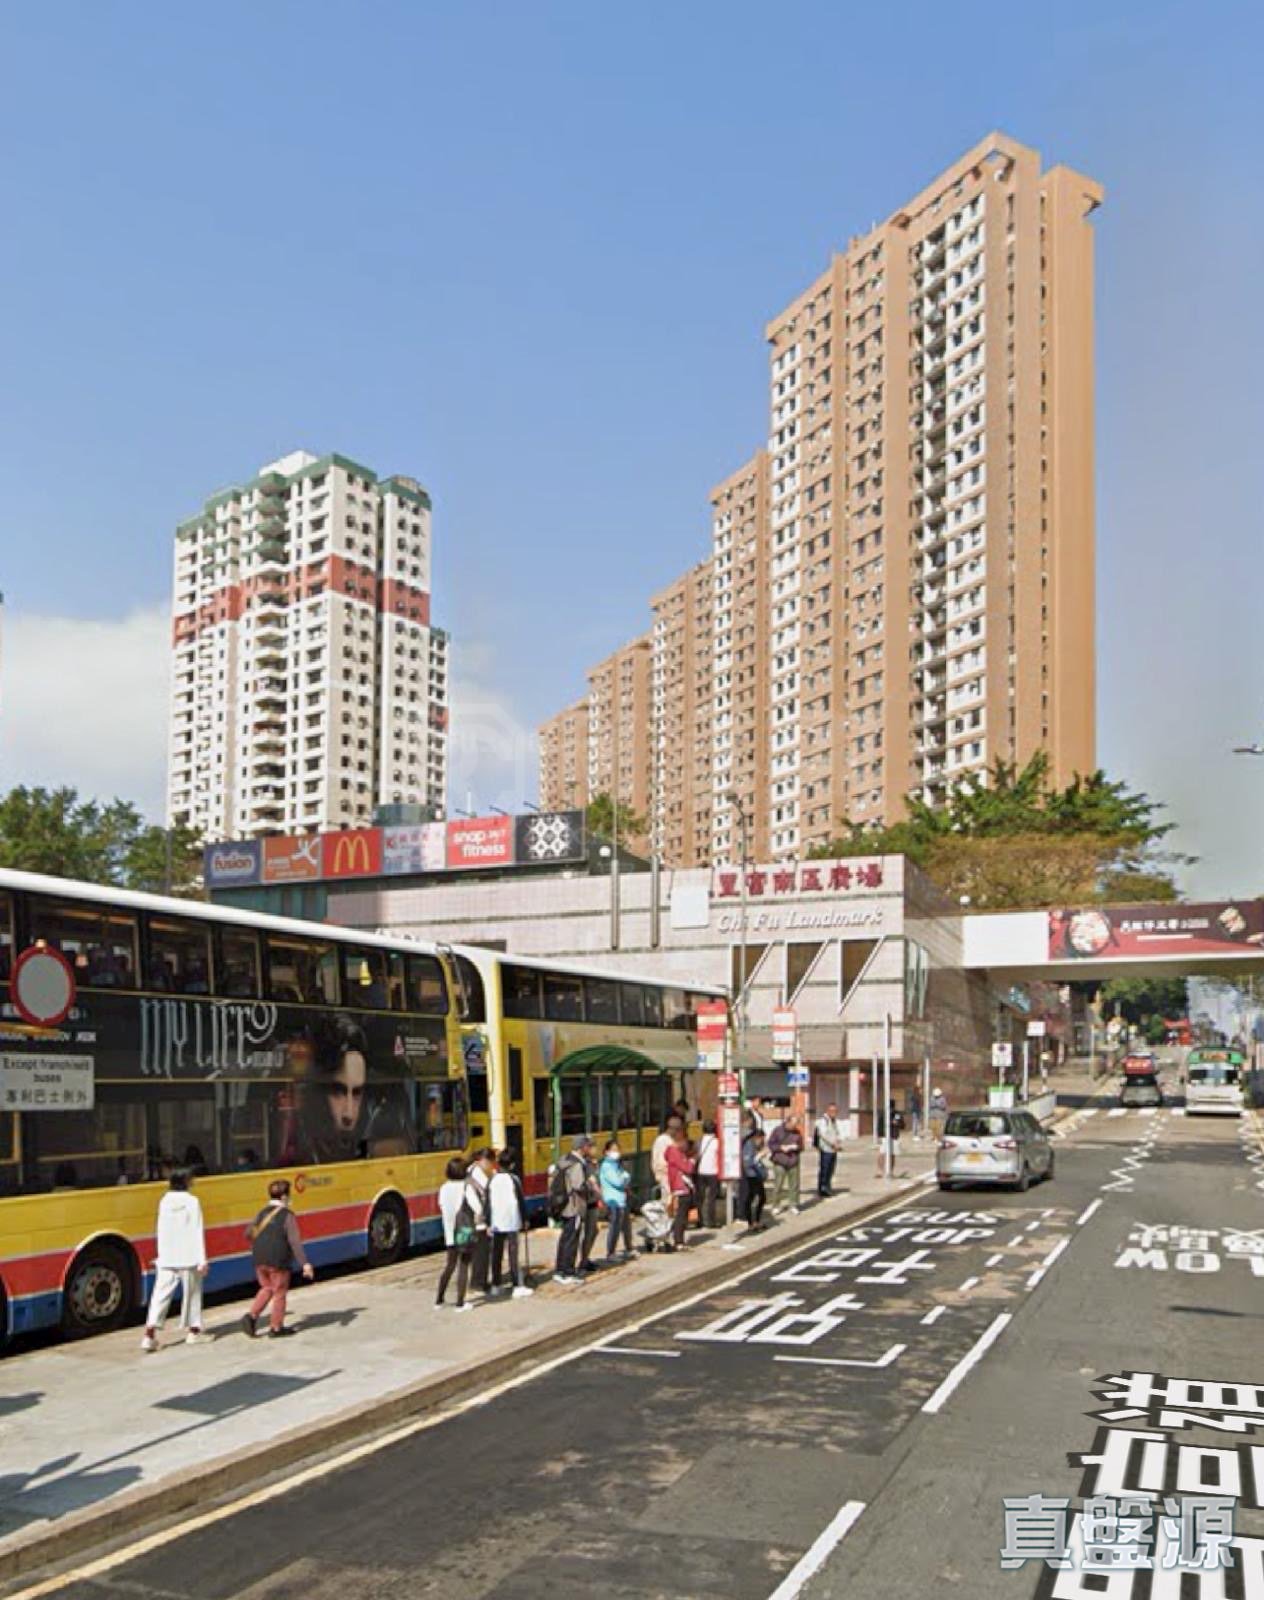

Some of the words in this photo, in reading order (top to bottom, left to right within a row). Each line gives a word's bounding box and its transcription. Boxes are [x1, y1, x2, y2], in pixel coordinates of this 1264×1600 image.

[454, 830, 486, 846] snap
[462, 844, 506, 858] fitness
[718, 912, 749, 934] Chi
[753, 913, 780, 932] Fu
[784, 905, 884, 930] Landmark
[3, 1057, 37, 1071] Except
[39, 1057, 89, 1071] franchised
[33, 1072, 62, 1083] buses
[5, 1088, 88, 1104] 專利巴士例外
[886, 1210, 999, 1224] BUS
[836, 1227, 996, 1245] STOP
[770, 1248, 936, 1284] 巴士
[673, 1291, 866, 1345] 站
